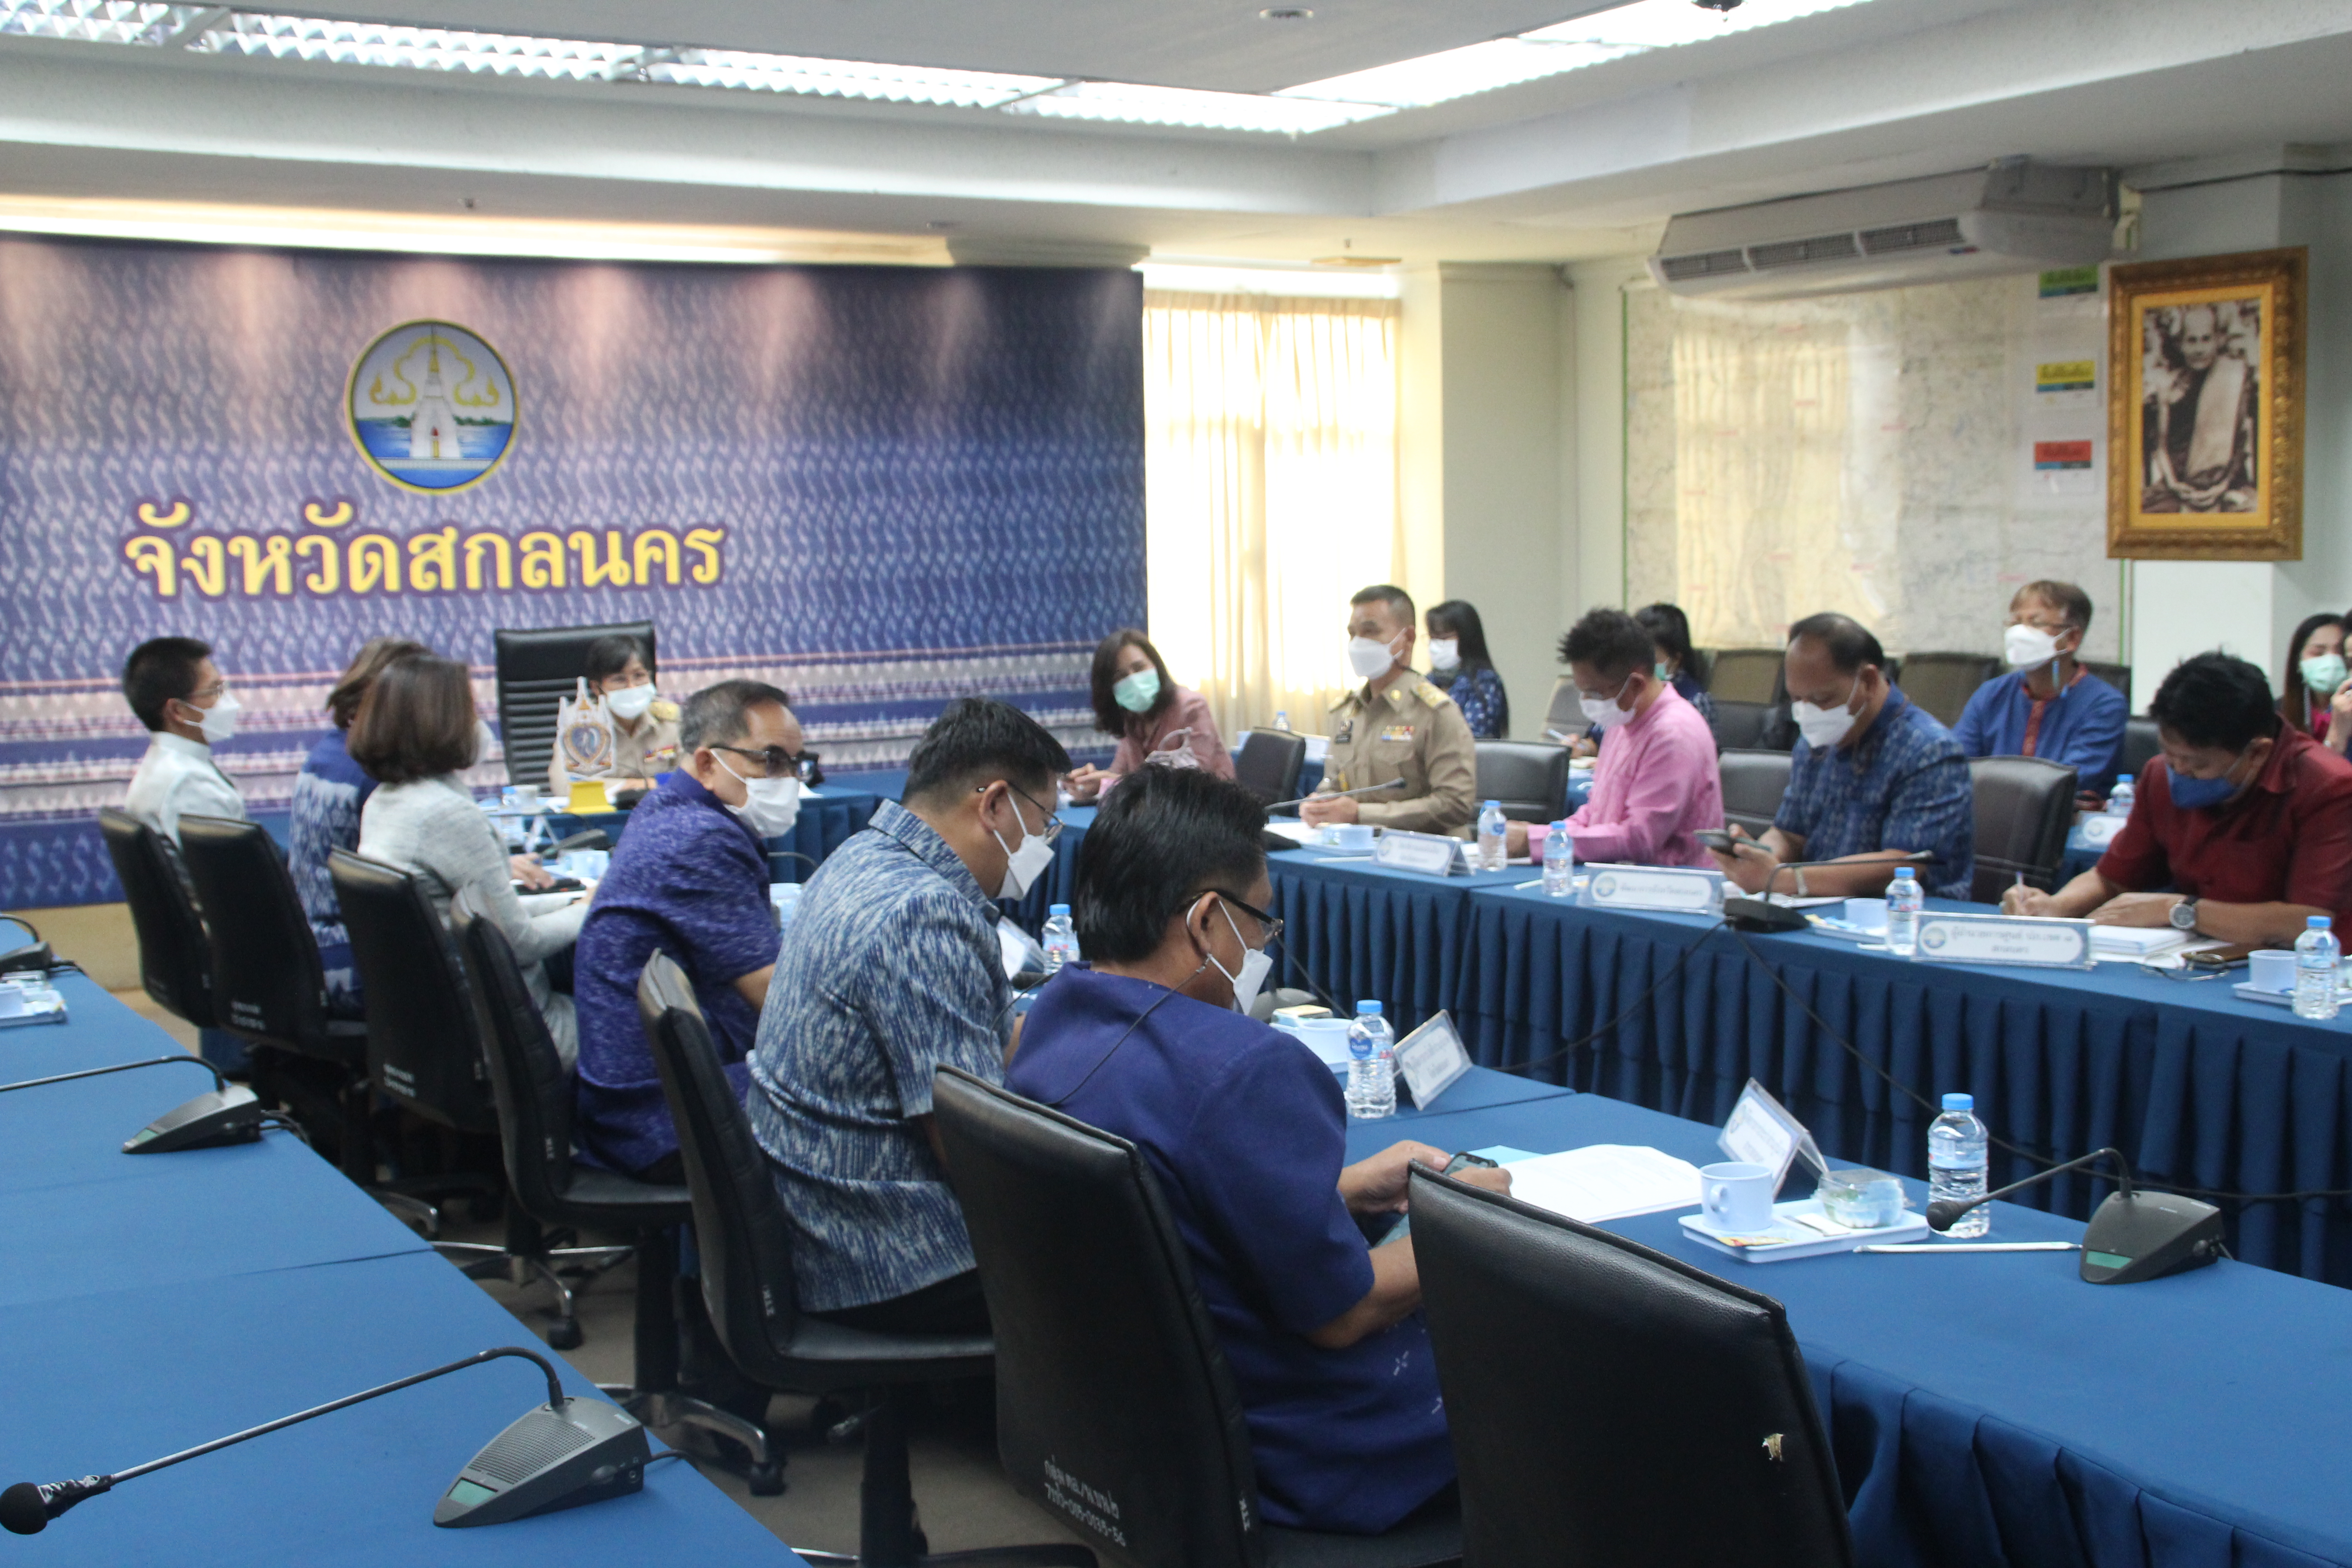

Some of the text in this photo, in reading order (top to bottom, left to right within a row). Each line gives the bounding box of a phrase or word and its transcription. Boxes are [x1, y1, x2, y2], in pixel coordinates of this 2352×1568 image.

[126, 501, 724, 596] จังหวัดสกลนคร
